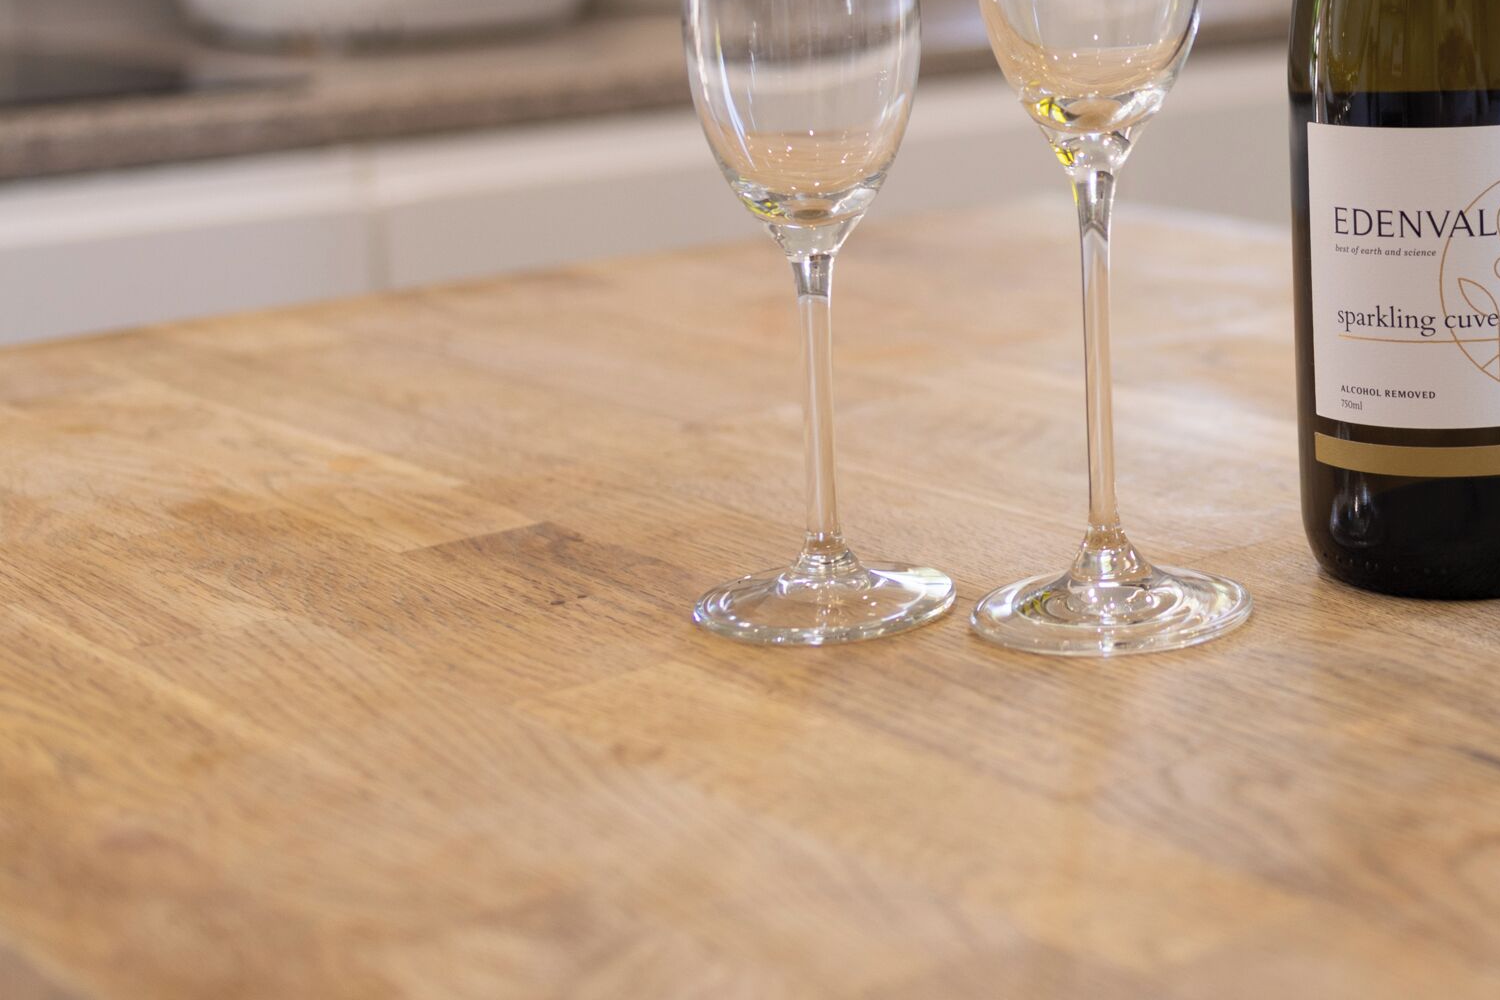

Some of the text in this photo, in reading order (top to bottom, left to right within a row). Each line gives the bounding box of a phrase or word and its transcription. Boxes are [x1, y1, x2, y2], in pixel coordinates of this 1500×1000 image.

[1335, 243, 1437, 257] best of earth and science
[1336, 304, 1436, 338] sparkling
[1340, 384, 1436, 400] ALCOHOL REMOVED
[1340, 398, 1363, 411] 750ml
